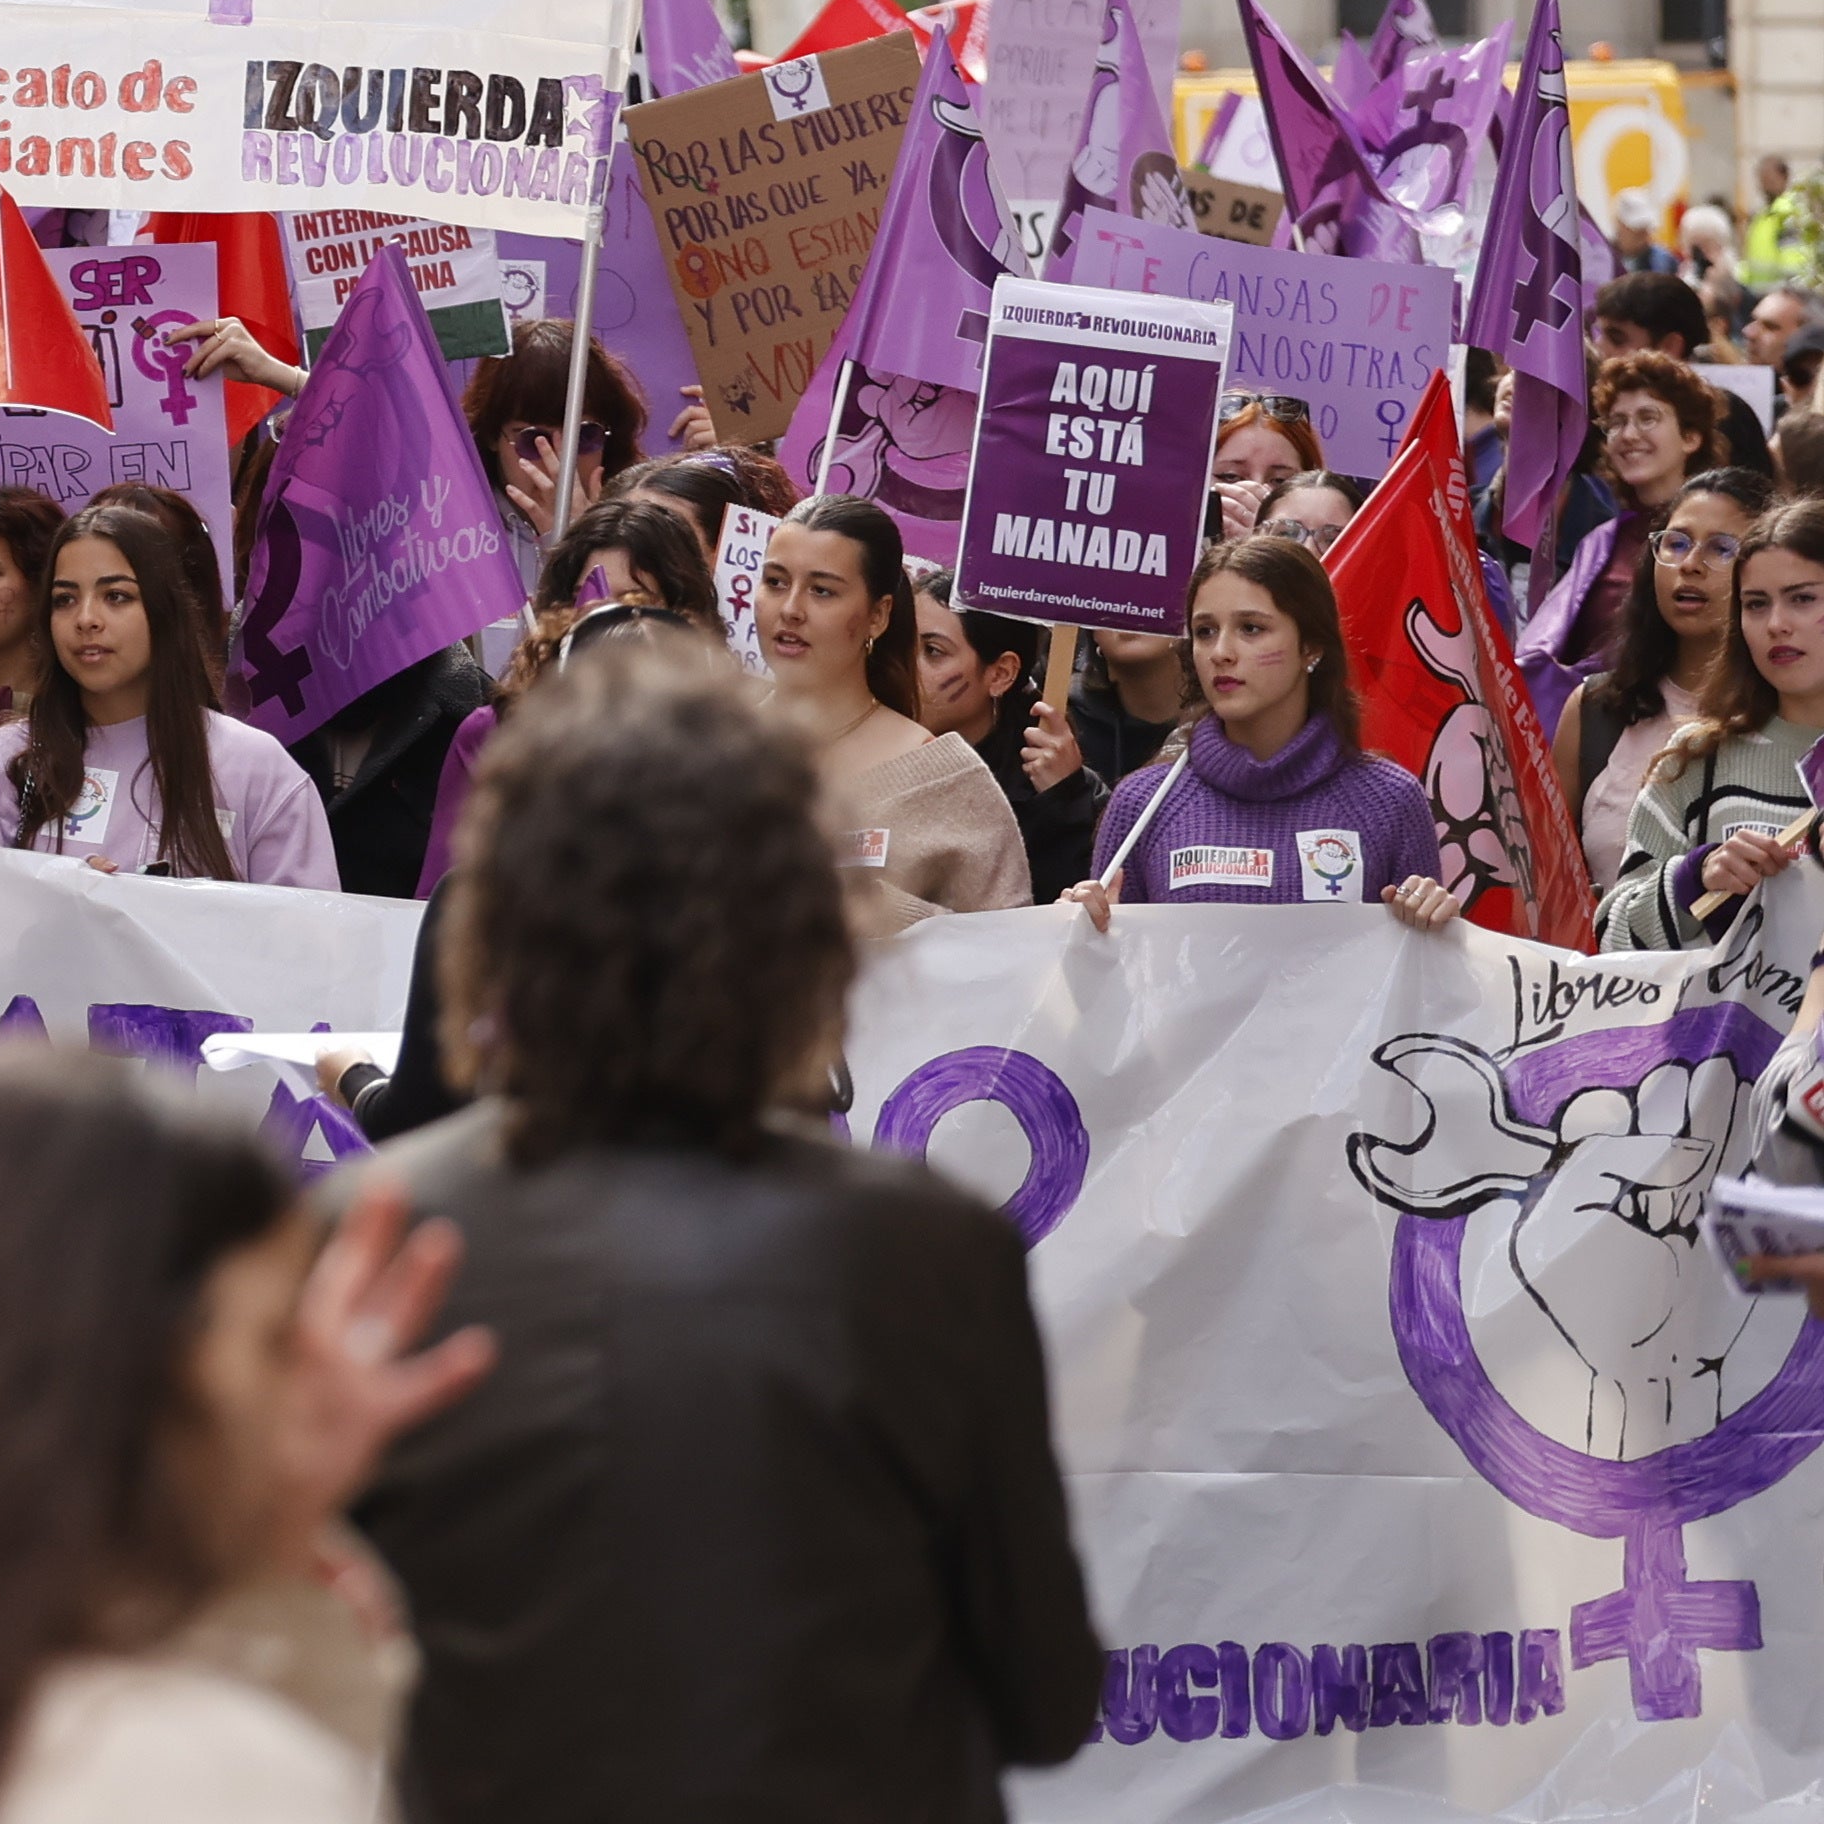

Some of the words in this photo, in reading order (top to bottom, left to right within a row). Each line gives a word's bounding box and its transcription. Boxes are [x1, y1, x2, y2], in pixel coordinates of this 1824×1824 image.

[118, 59, 198, 112] de
[243, 60, 566, 148] IZQUIERDA
[719, 121, 787, 177] LAS
[664, 198, 731, 250] POR
[770, 173, 829, 219] QUE
[305, 236, 357, 275] CON
[714, 236, 771, 283] NO
[70, 256, 162, 311] SER
[1187, 251, 1338, 325] CANSAS
[1366, 282, 1420, 332] DE
[692, 298, 716, 348] Y
[731, 283, 804, 335] POR
[1002, 304, 1073, 328] IZQUIERDA
[1092, 315, 1218, 347] REVOLUCIONARIA
[1049, 361, 1158, 414] AQUÍ
[1235, 330, 1432, 392] NOSOTRAS
[109, 440, 192, 492] EN
[1045, 414, 1145, 467] ESTÁ
[420, 475, 451, 529] y
[1063, 468, 1116, 516] TU
[724, 542, 763, 571] LOS
[992, 512, 1168, 577] MANADA
[317, 520, 500, 671] Combativas
[978, 581, 1166, 621] izquierdarevolucionaria.net
[1173, 849, 1248, 868] IZQUIERDA
[1173, 861, 1270, 880] REVOLUCIONARIA
[1491, 954, 1662, 1065] Libres
[1090, 1628, 1566, 1746] UCIONARIA
